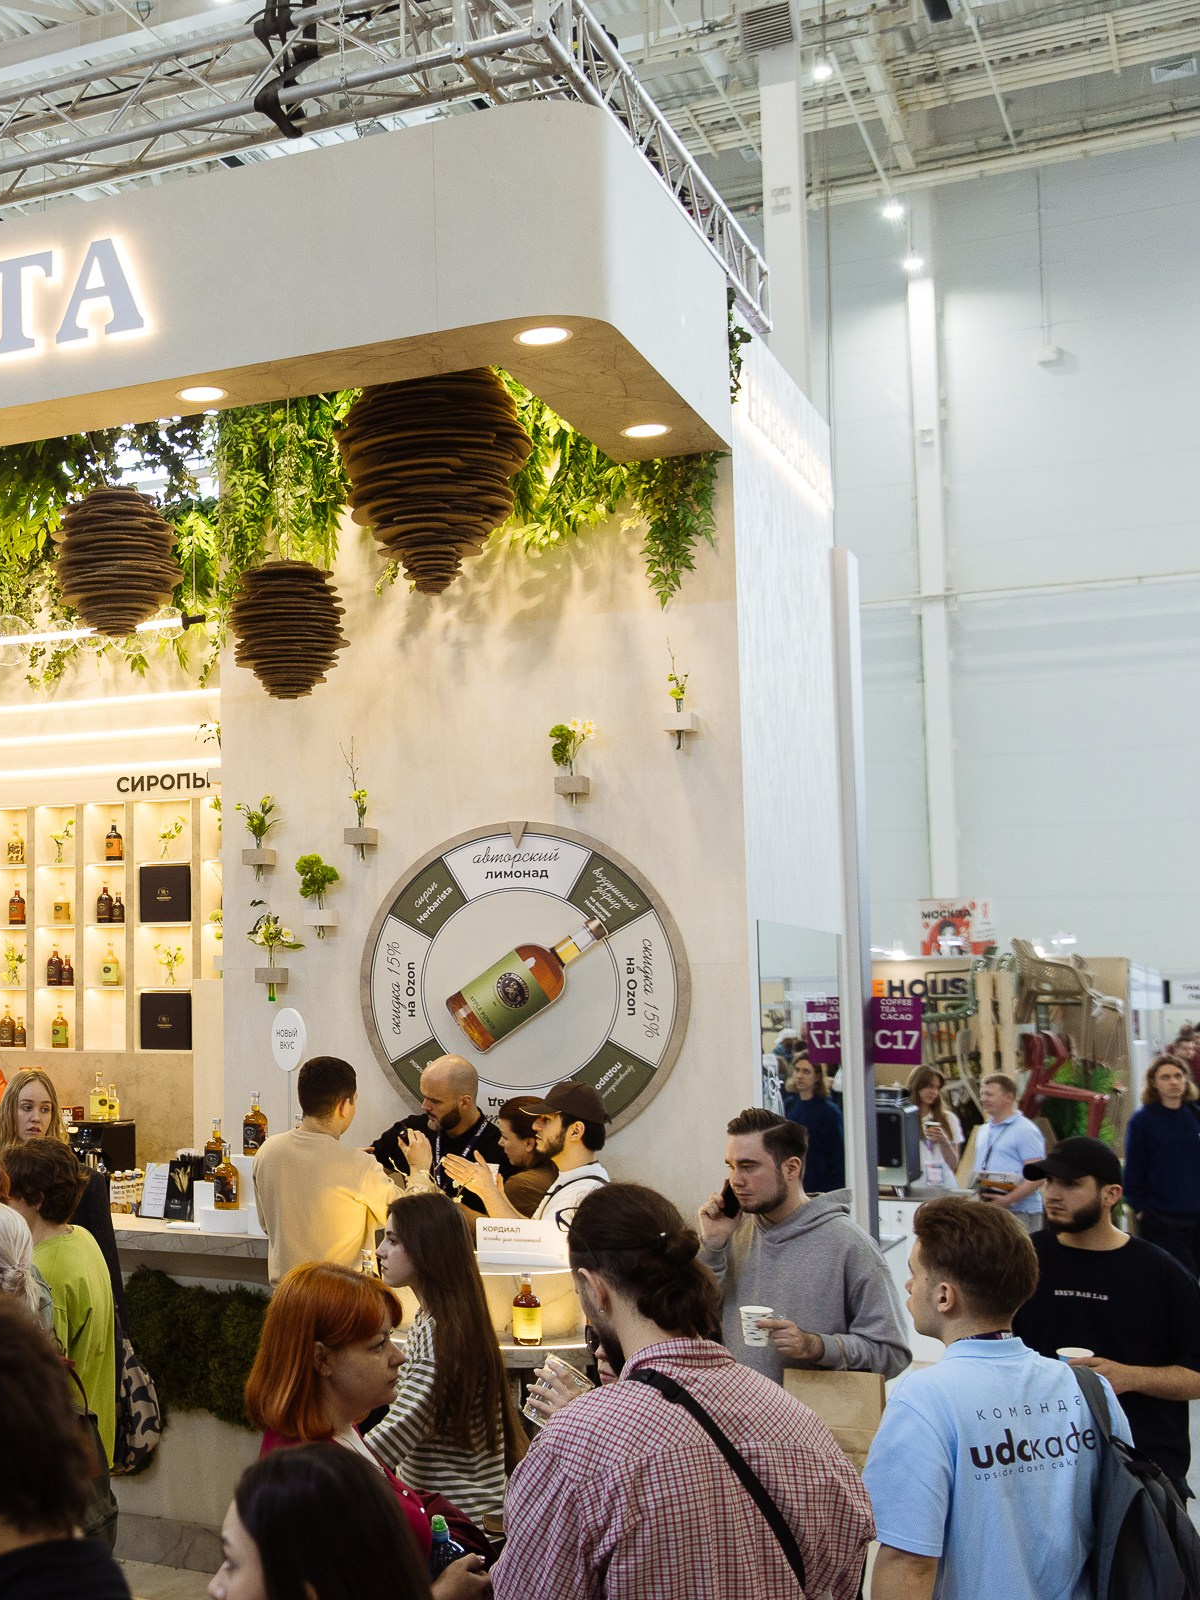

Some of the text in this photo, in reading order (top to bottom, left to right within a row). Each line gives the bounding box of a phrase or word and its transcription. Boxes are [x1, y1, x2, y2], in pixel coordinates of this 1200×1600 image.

[117, 772, 210, 792] СИРОПЫ
[472, 846, 560, 868] авторский
[485, 869, 549, 879] лимонад
[414, 882, 438, 908] сироп
[416, 887, 453, 924] Herbarista
[386, 942, 407, 1035] скидка 15%
[406, 962, 415, 1017] на Ozon
[626, 958, 637, 1016] на Ozon
[636, 939, 660, 1038] скидка 15%
[470, 996, 482, 1011] APPLE
[880, 998, 912, 1006] COFFEE
[276, 1028, 298, 1037] НОВЫЙ
[874, 1029, 920, 1050] C17
[280, 1041, 295, 1049] ВКУС
[594, 1061, 623, 1090] подаро
[976, 1395, 1081, 1420] команда
[975, 1467, 1013, 1481] upside
[1018, 1464, 1045, 1473] down
